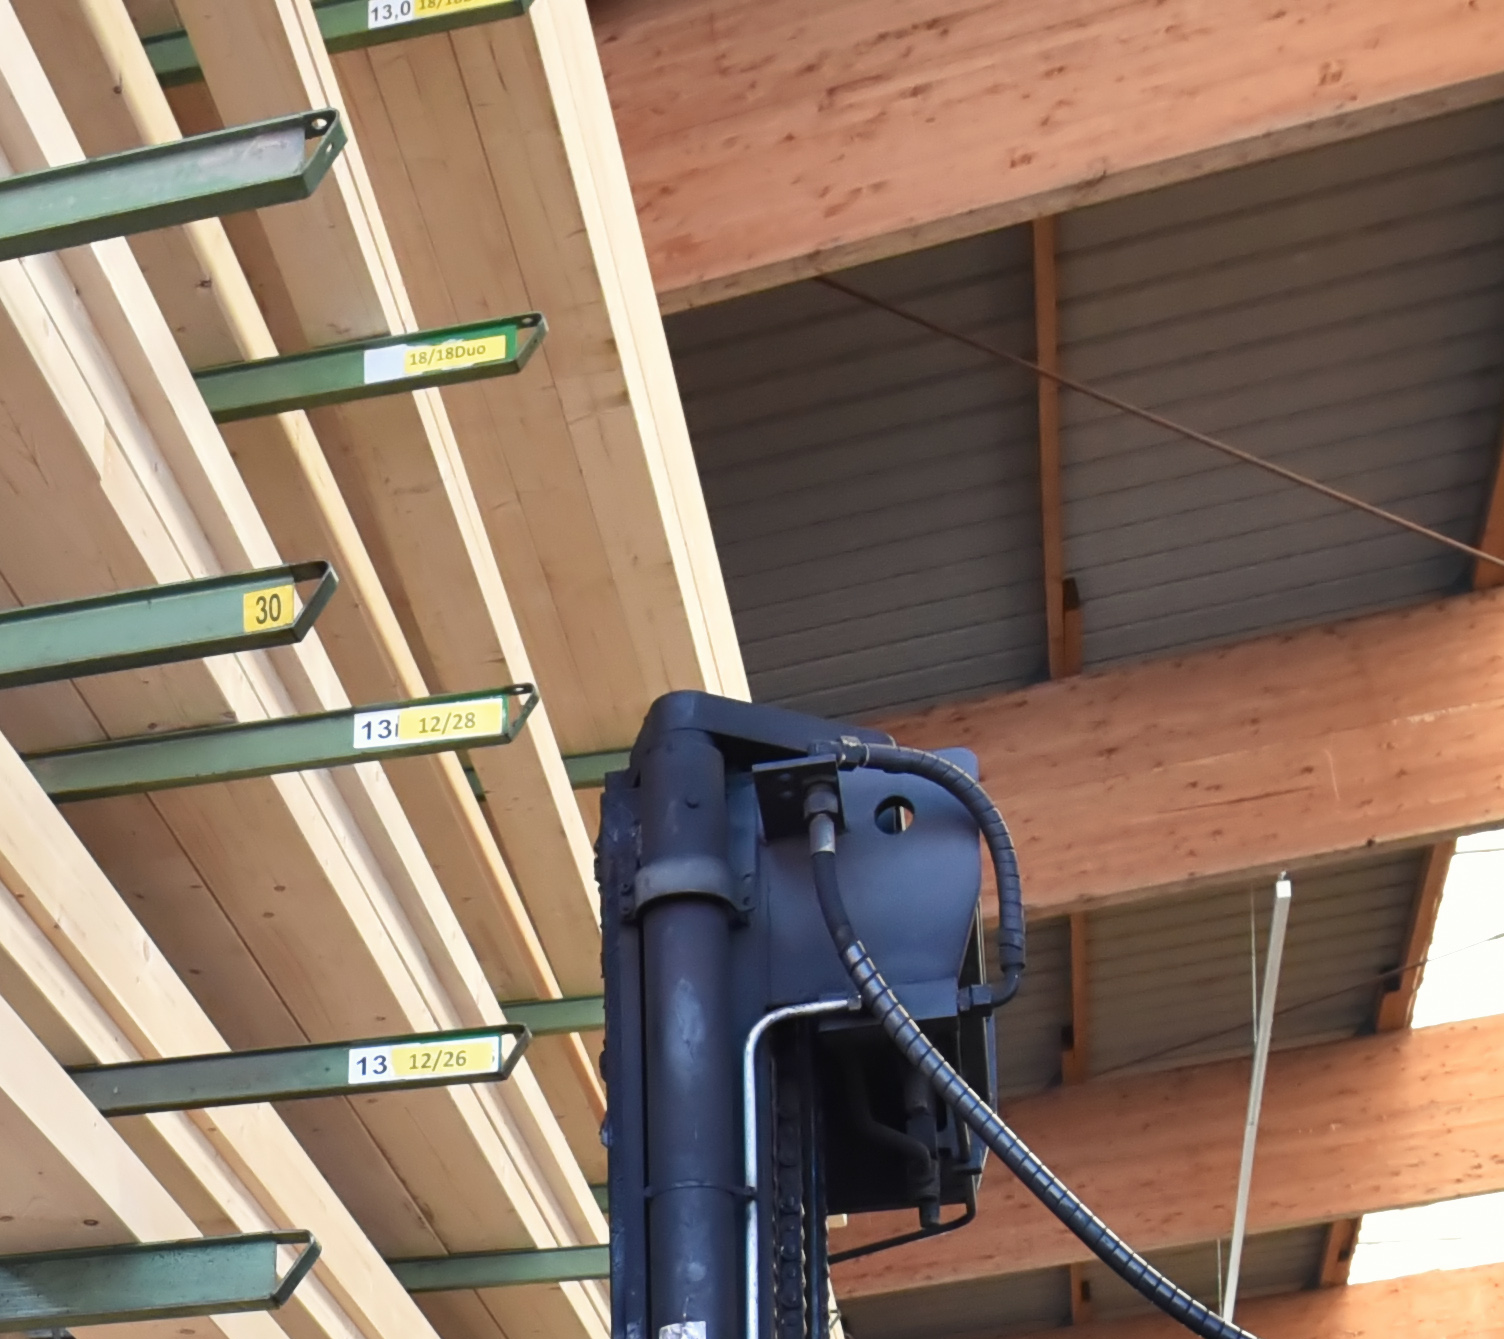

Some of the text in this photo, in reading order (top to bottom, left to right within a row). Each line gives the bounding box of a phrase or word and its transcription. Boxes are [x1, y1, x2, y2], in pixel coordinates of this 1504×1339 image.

[410, 345, 486, 366] 18/18Duo
[255, 593, 282, 625] 30
[361, 712, 476, 740] 13 12/28
[356, 1054, 387, 1076] 13
[409, 1049, 467, 1072] 12/26
